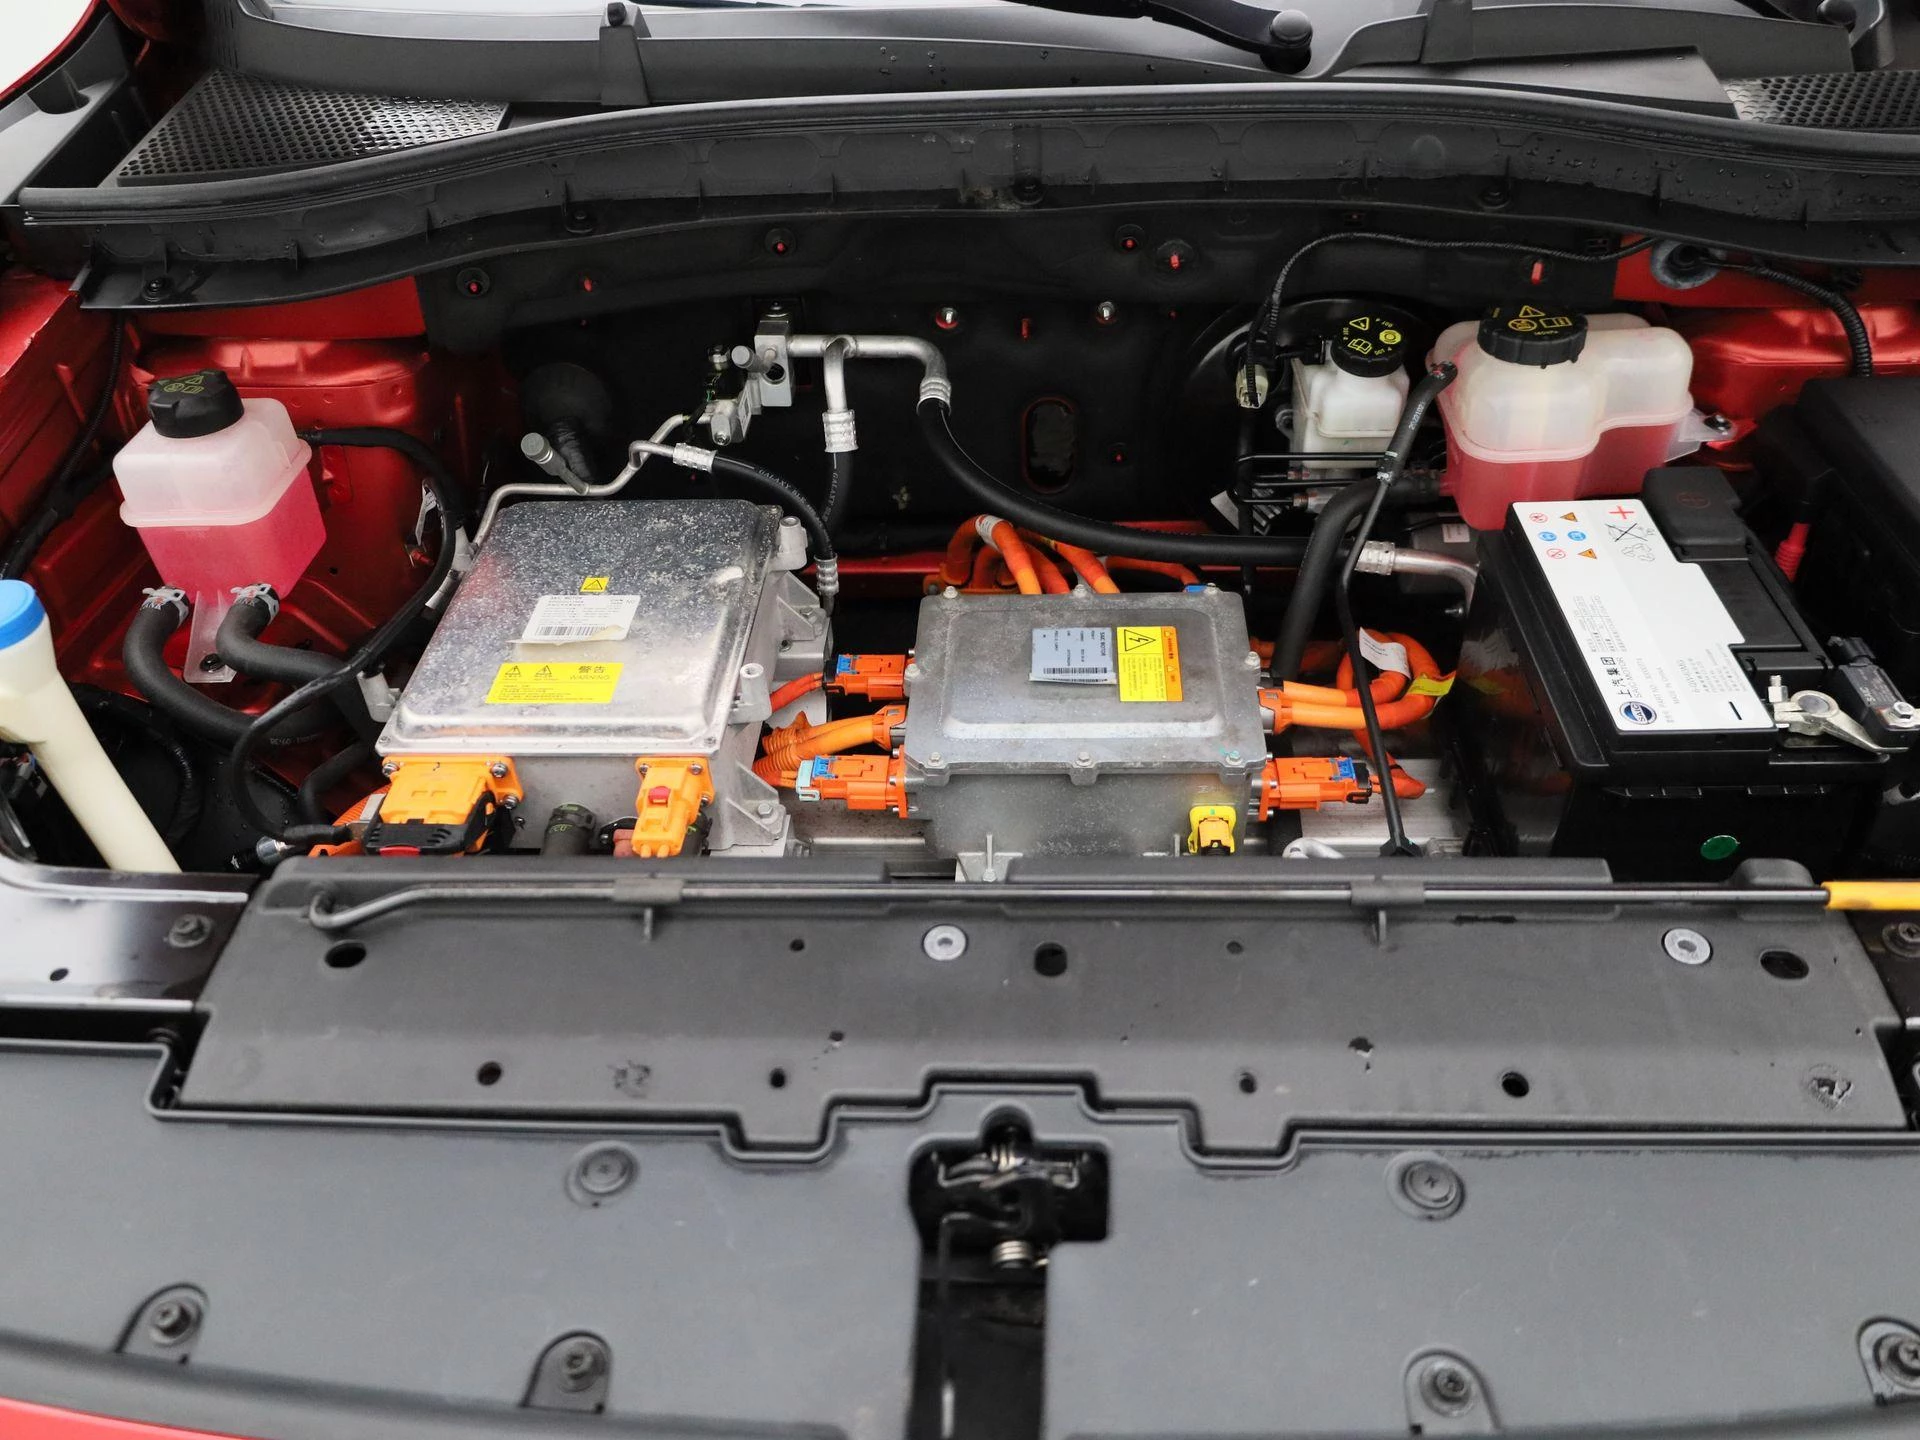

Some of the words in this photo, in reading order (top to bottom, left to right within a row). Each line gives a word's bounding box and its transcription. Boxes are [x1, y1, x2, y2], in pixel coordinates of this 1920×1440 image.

[1600, 656, 1632, 698] 上汽集团
[1631, 703, 1646, 722] SAIC
